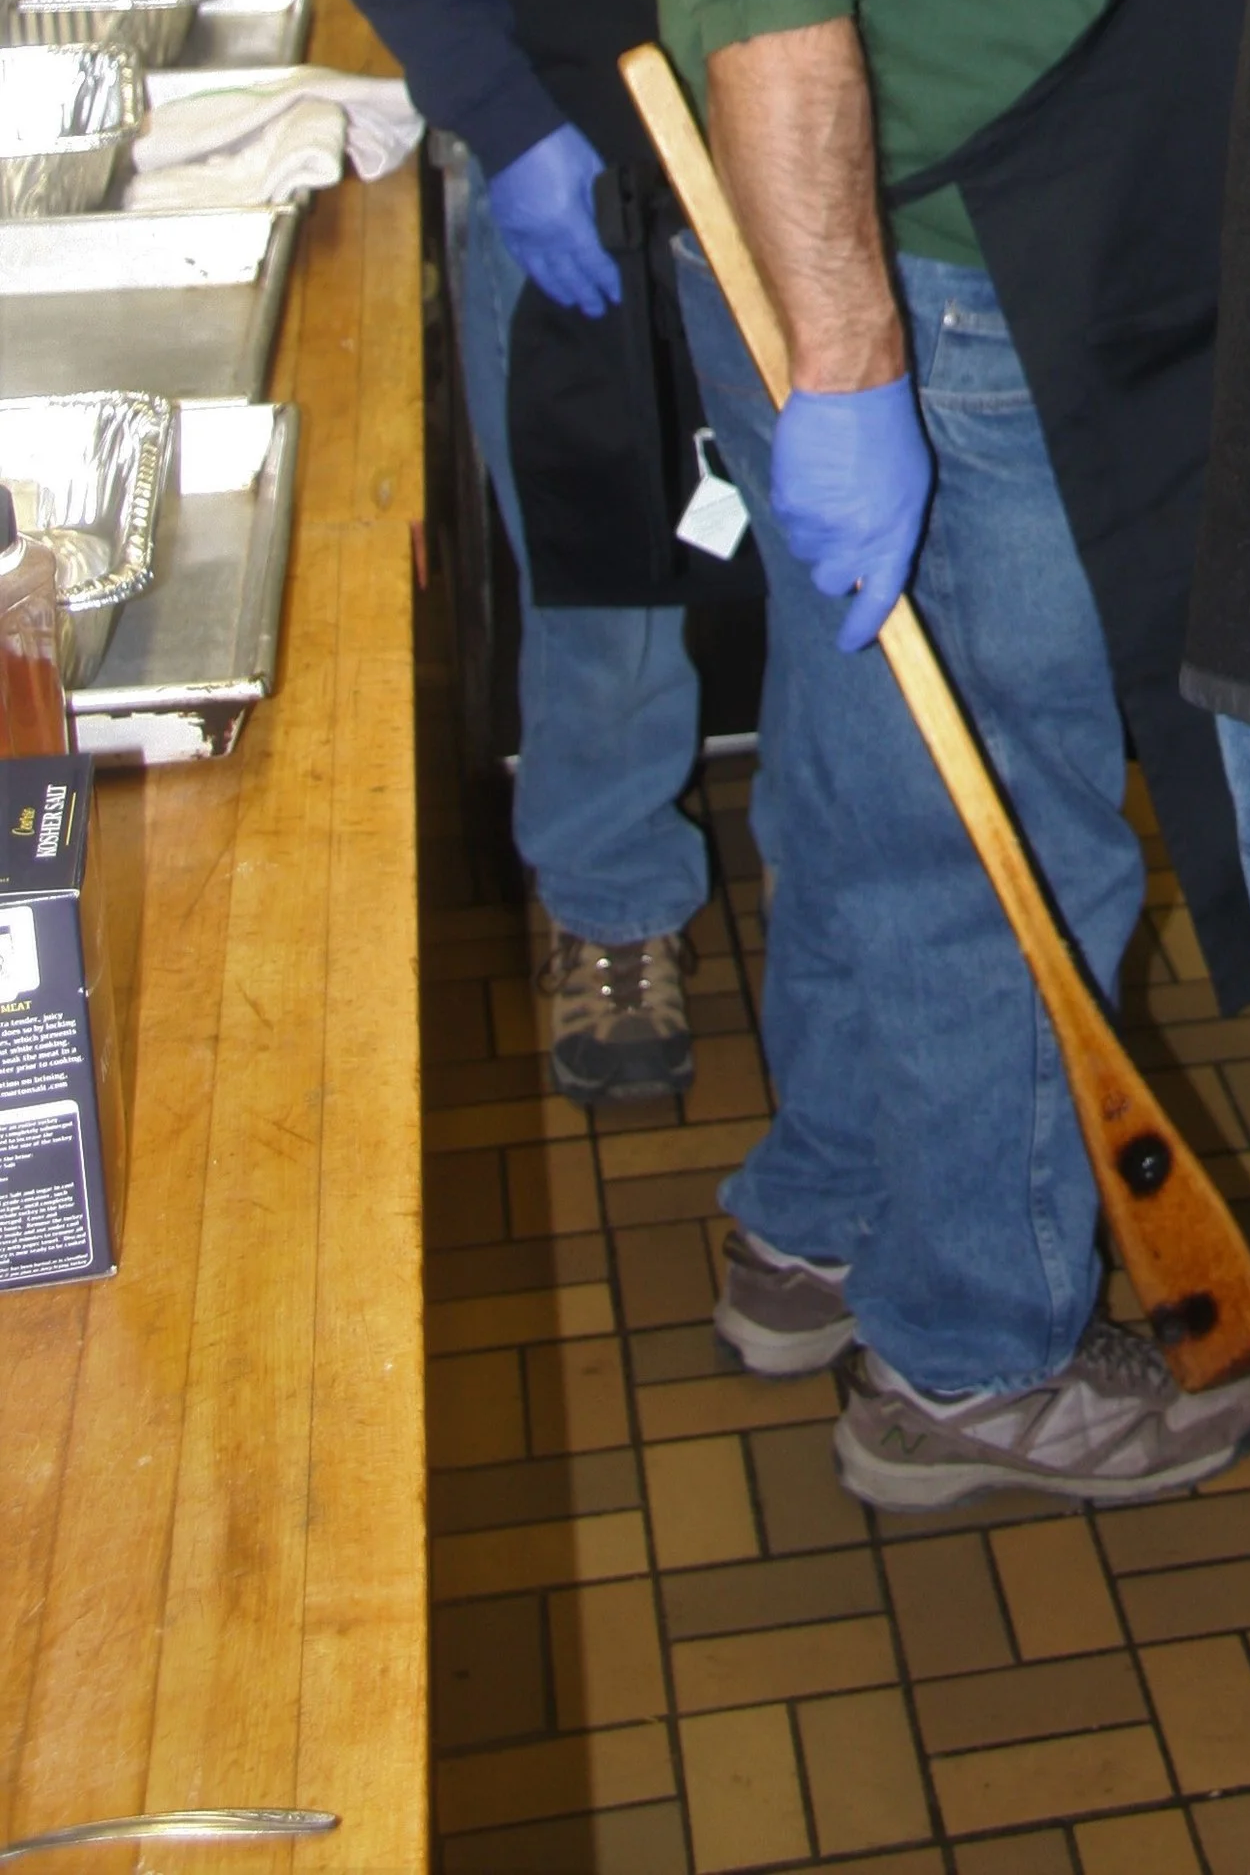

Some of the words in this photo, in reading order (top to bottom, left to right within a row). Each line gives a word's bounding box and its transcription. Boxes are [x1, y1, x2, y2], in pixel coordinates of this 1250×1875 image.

[44, 784, 67, 810] SALT
[36, 811, 63, 858] KOSHER
[0, 1000, 32, 1013] MEAT
